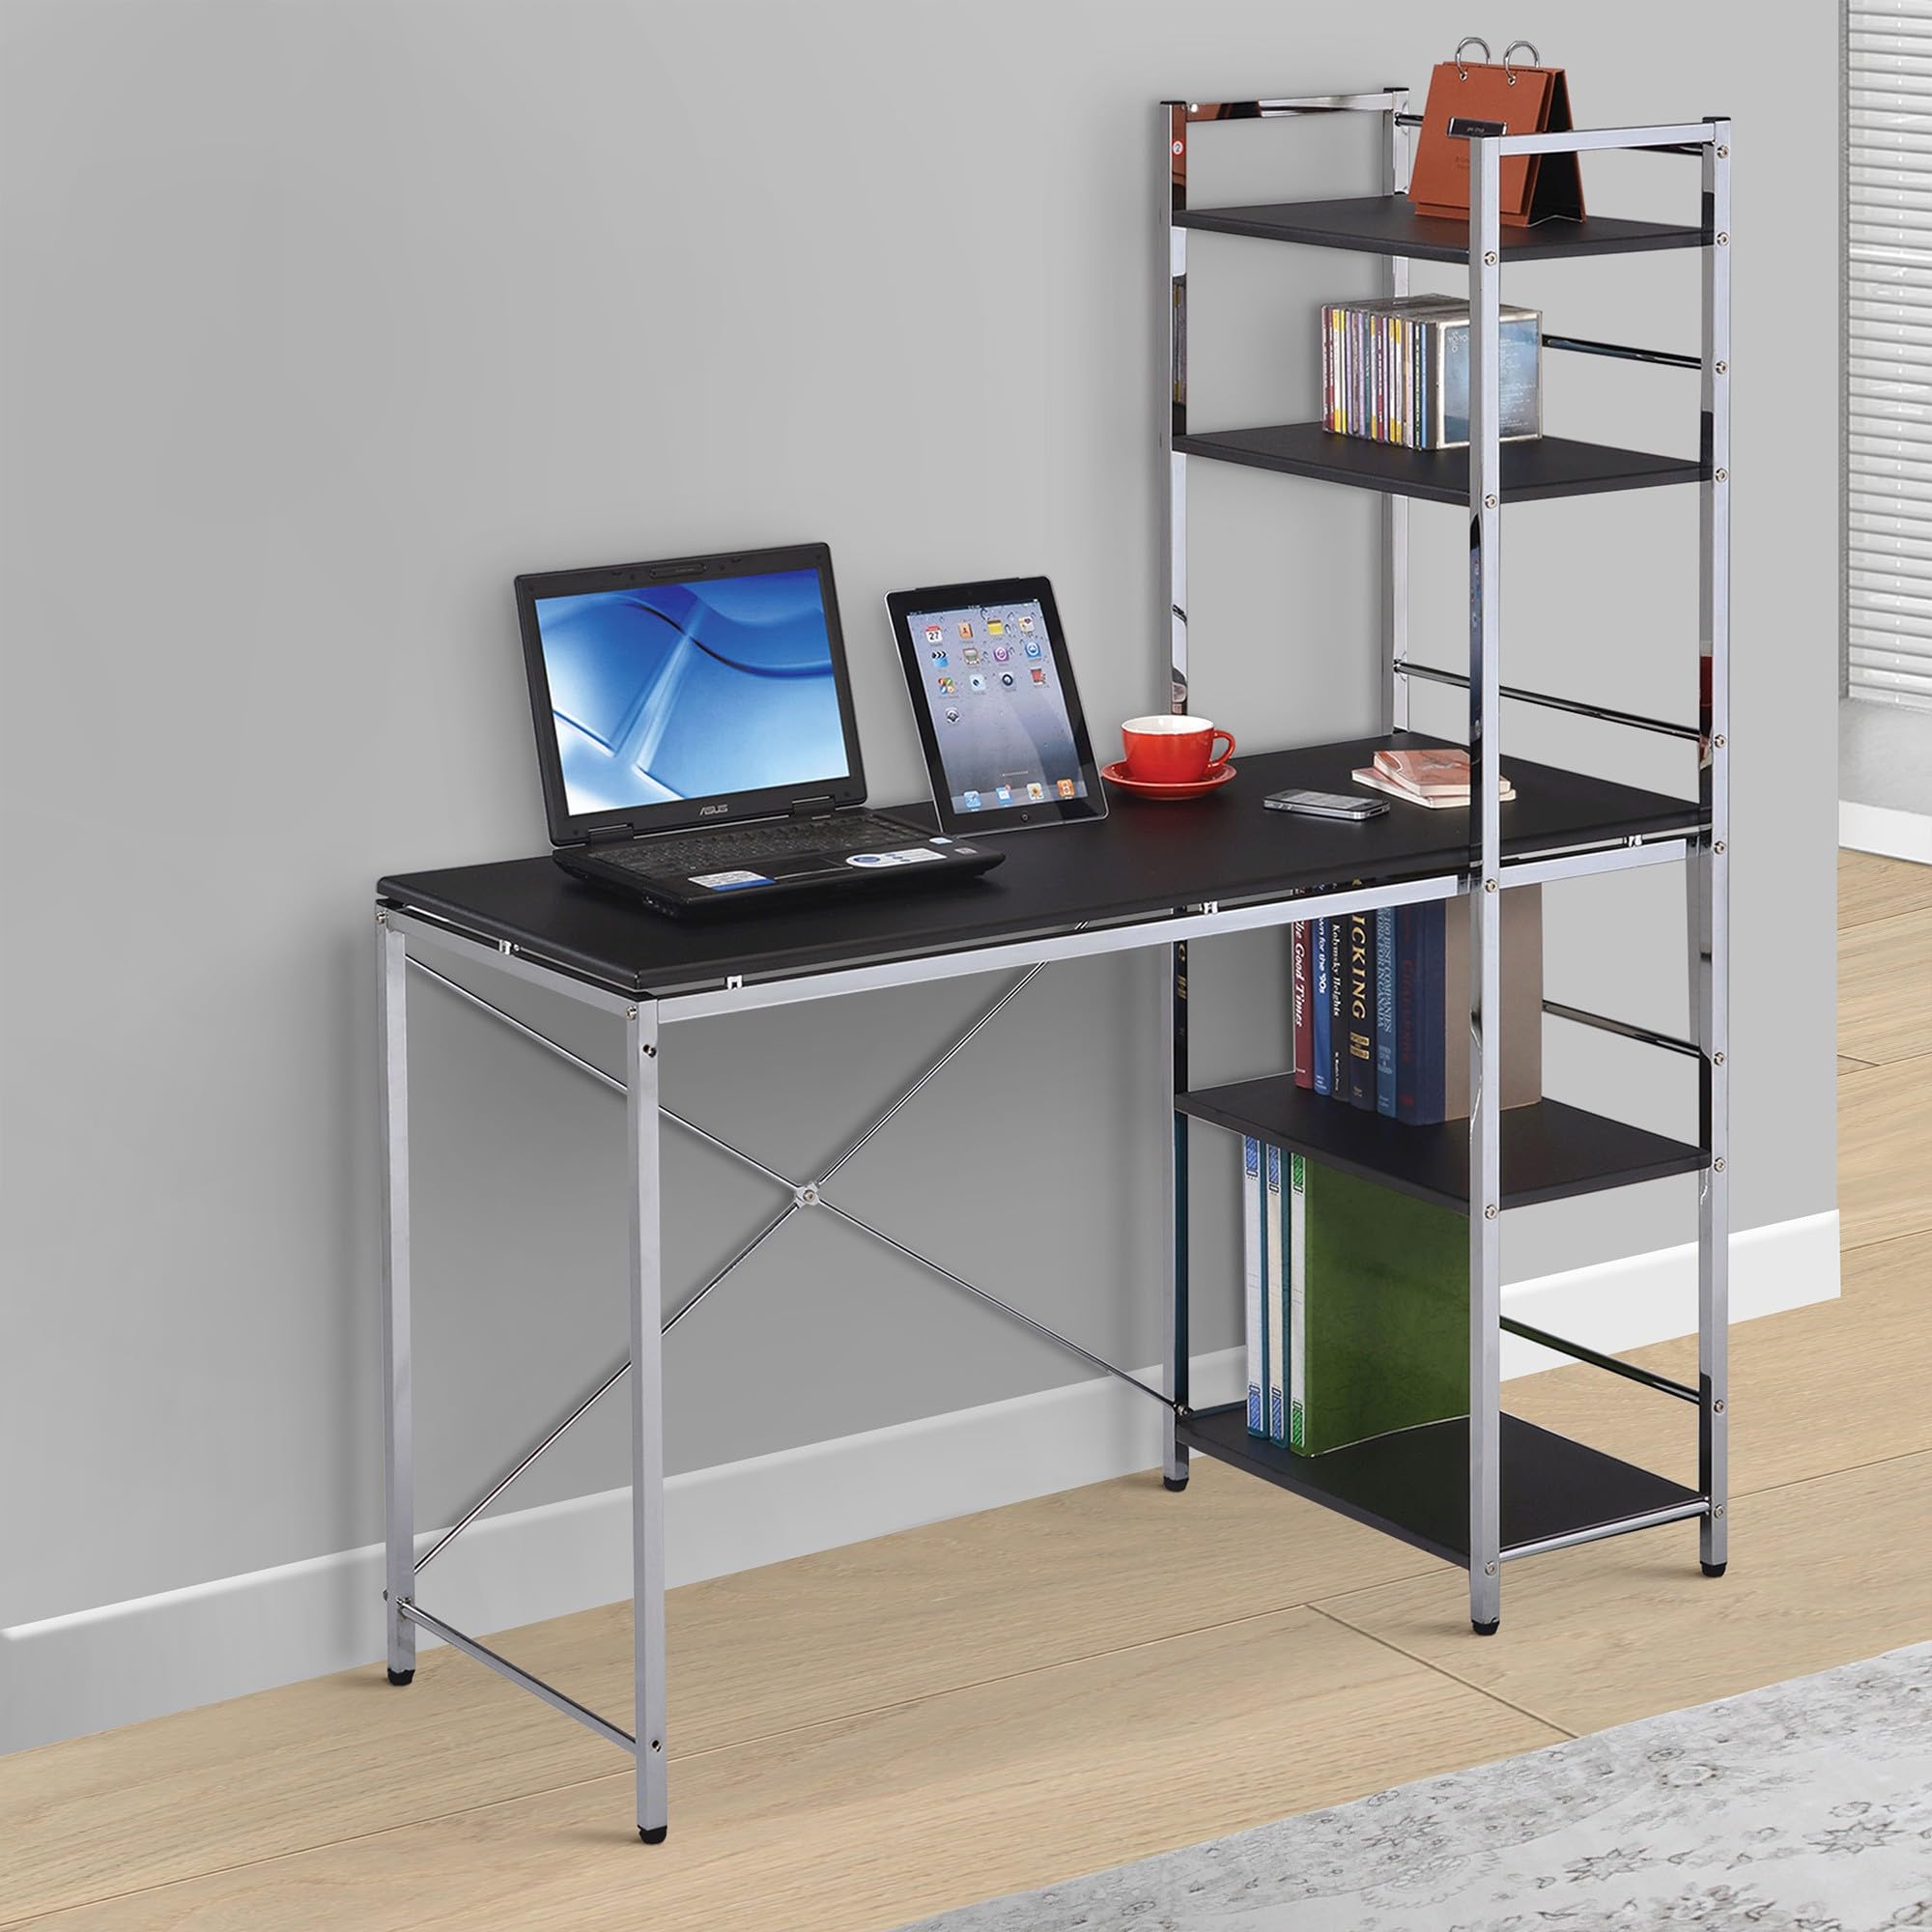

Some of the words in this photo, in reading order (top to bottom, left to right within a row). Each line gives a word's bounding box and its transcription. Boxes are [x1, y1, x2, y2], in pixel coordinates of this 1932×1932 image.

[928, 631, 939, 640] 27
[699, 804, 728, 816] ASUS
[1294, 942, 1305, 982] Good
[1377, 941, 1385, 966] FOR
[1294, 983, 1305, 1027] Times
[1332, 976, 1342, 1017] Heights
[1377, 983, 1385, 1028] CANADA
[1383, 966, 1392, 1033] COMPANIES
